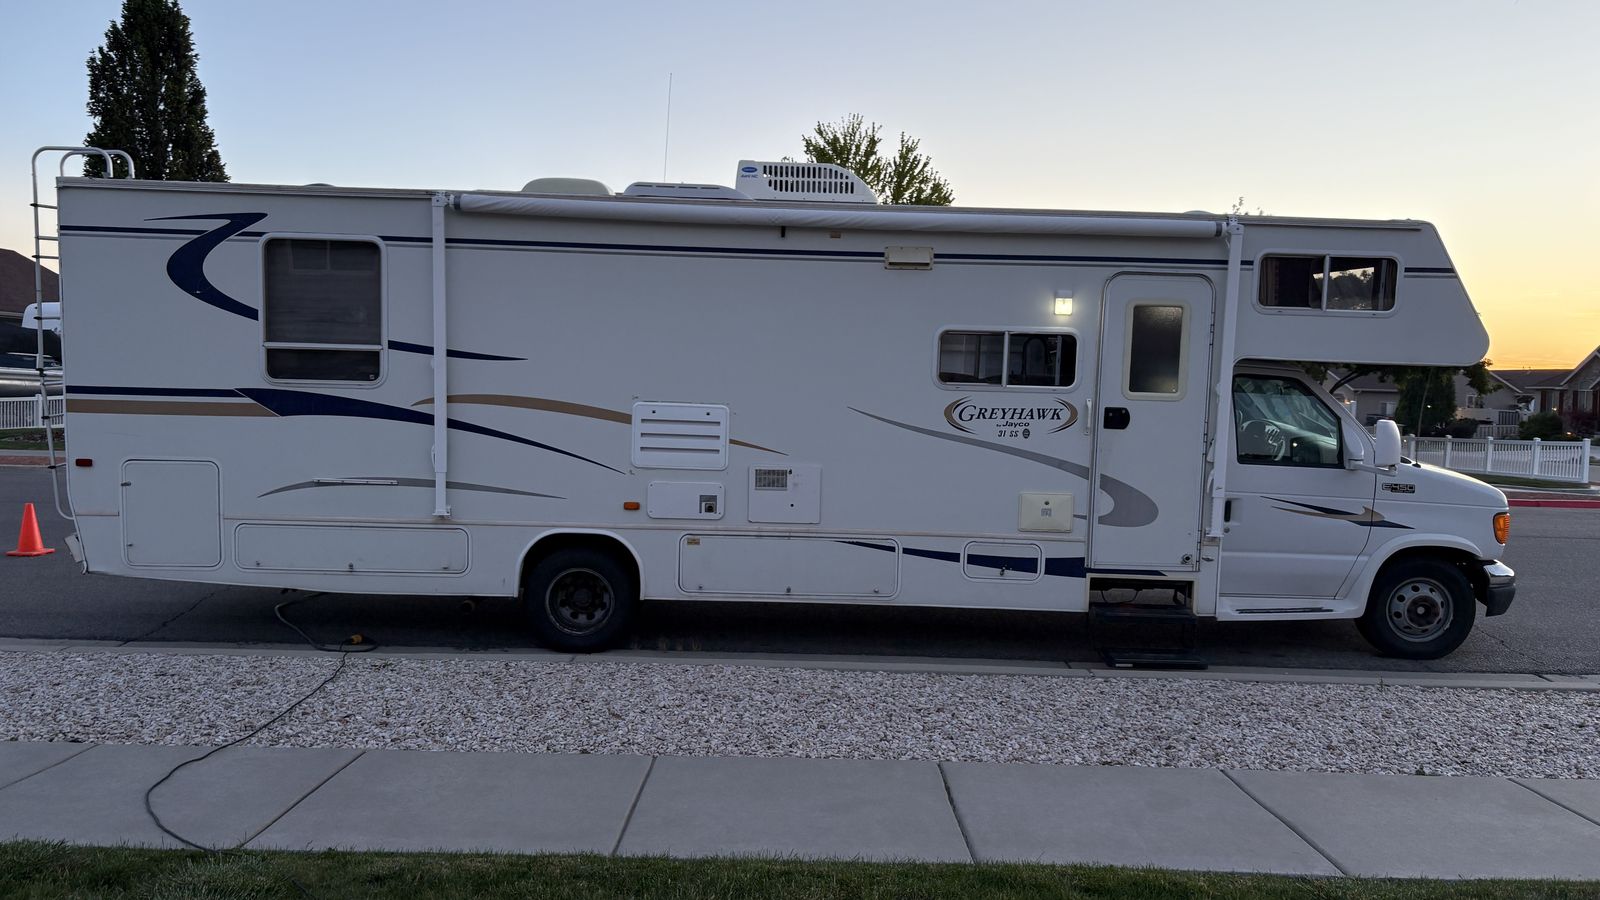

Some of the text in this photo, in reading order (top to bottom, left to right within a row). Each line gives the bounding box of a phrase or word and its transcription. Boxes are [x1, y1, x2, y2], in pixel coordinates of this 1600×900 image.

[959, 405, 1064, 421] GREYHAWK
[998, 430, 1006, 438] 31
[1010, 430, 1019, 438] SS
